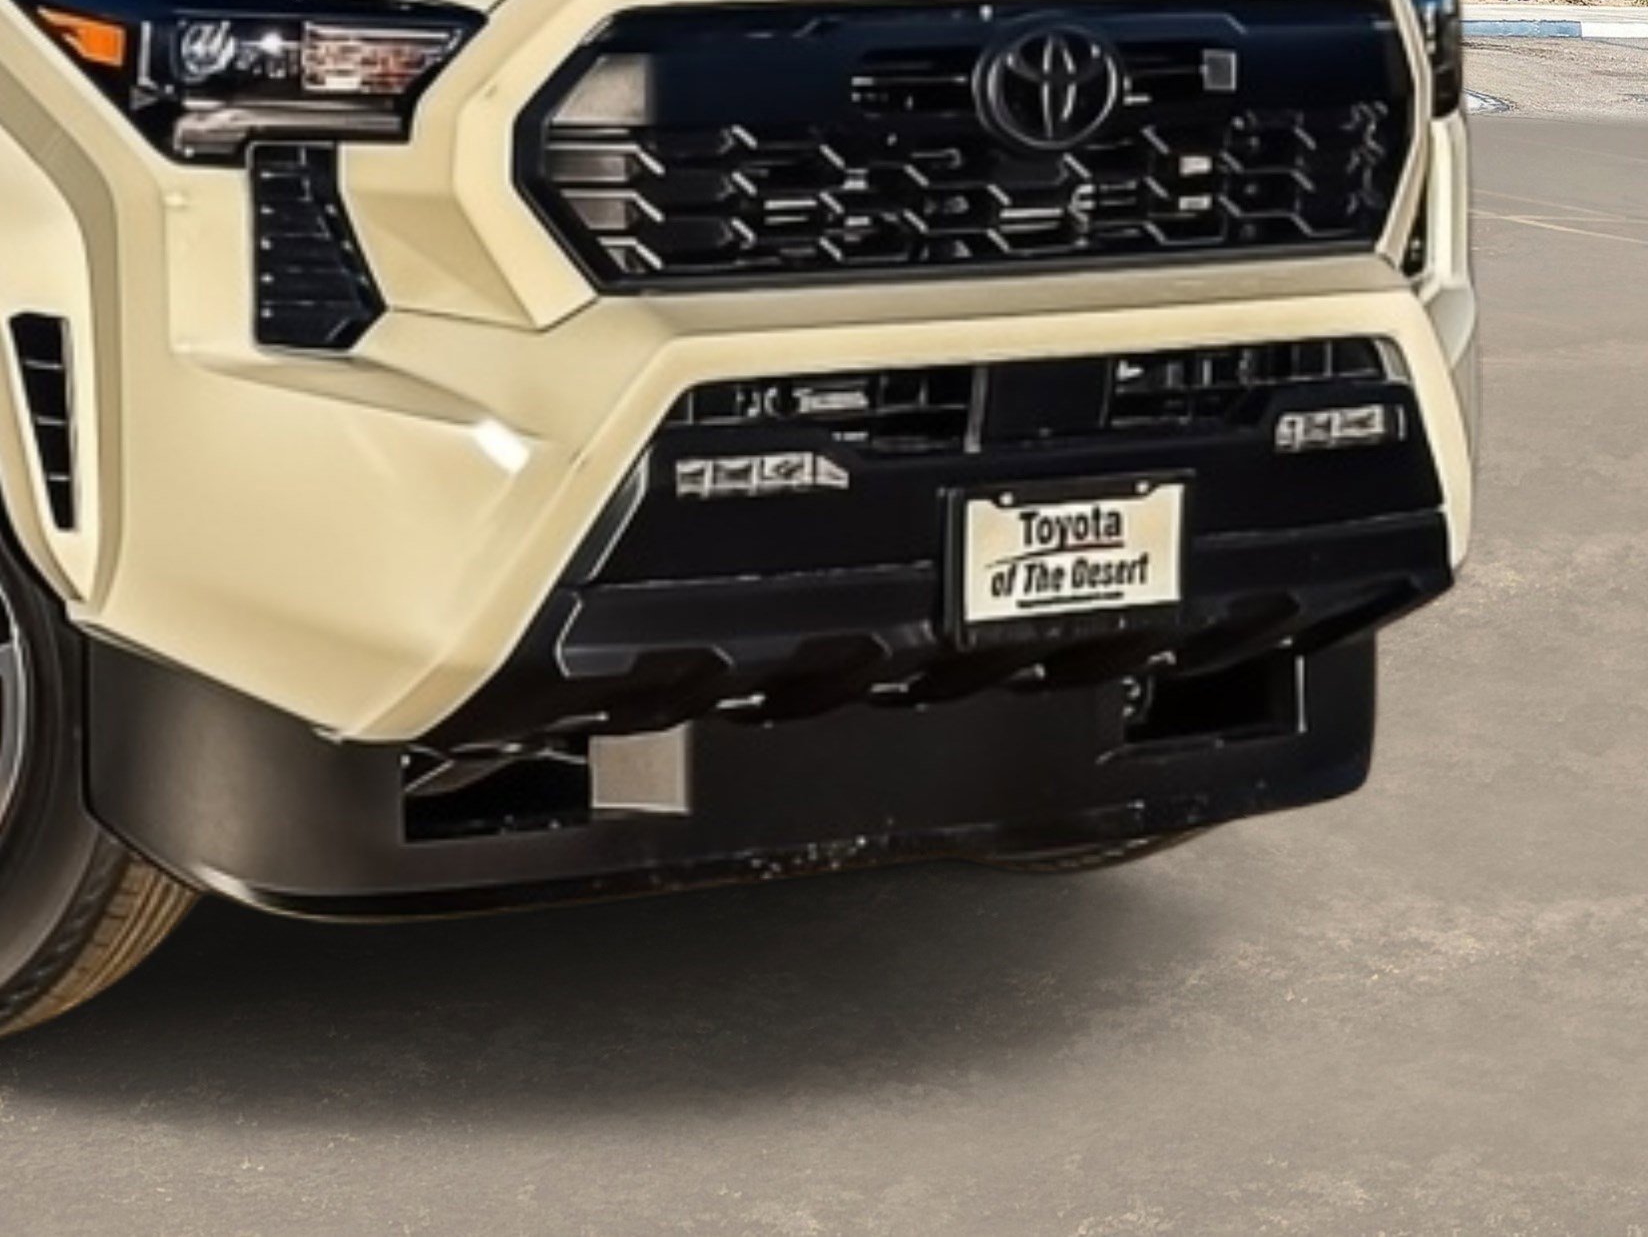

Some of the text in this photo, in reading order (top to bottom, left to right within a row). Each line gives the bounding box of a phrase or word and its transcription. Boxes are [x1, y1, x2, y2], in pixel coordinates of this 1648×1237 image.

[1019, 507, 1122, 547] Toyota
[991, 552, 1150, 598] of The Desert
